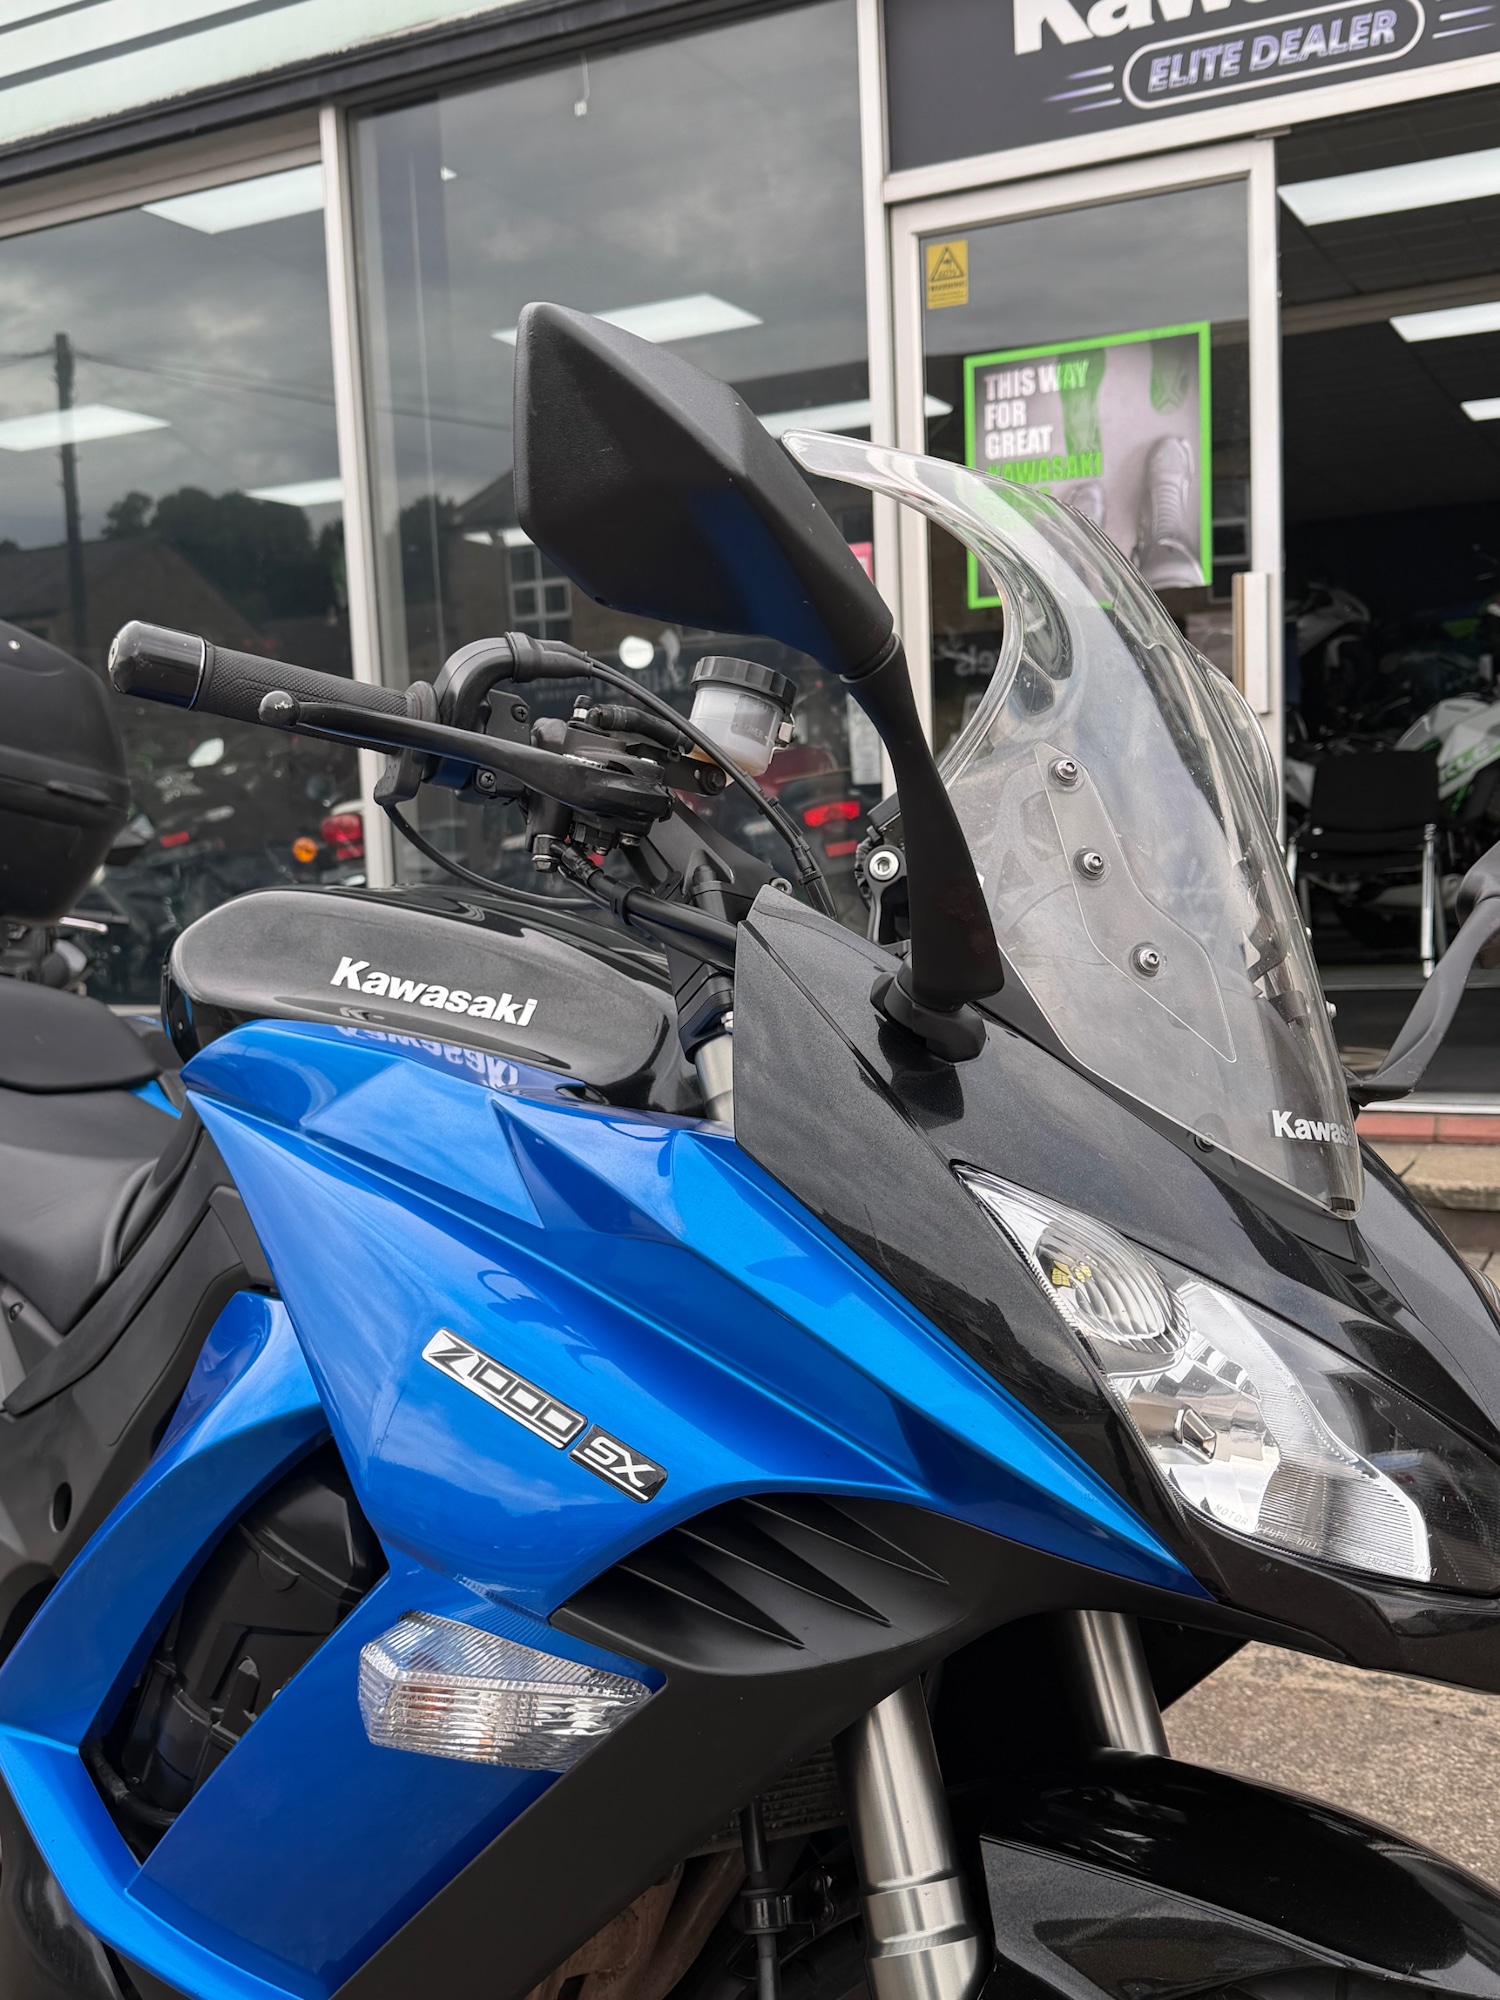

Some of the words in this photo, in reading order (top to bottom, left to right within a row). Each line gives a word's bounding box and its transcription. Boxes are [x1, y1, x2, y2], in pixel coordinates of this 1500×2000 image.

[1148, 40, 1244, 93] ELITE
[1248, 9, 1398, 72] DEALER
[984, 367, 1036, 401] THIS
[1037, 359, 1089, 394] WAY
[984, 400, 1027, 431] FOR
[984, 424, 1054, 460] GREAT
[987, 451, 1103, 485] KAWASAKI
[330, 956, 538, 1027] Kawasaki
[428, 1331, 583, 1439] Z1000
[583, 1436, 657, 1488] SX
[1213, 1504, 1249, 1526] MOTOR
